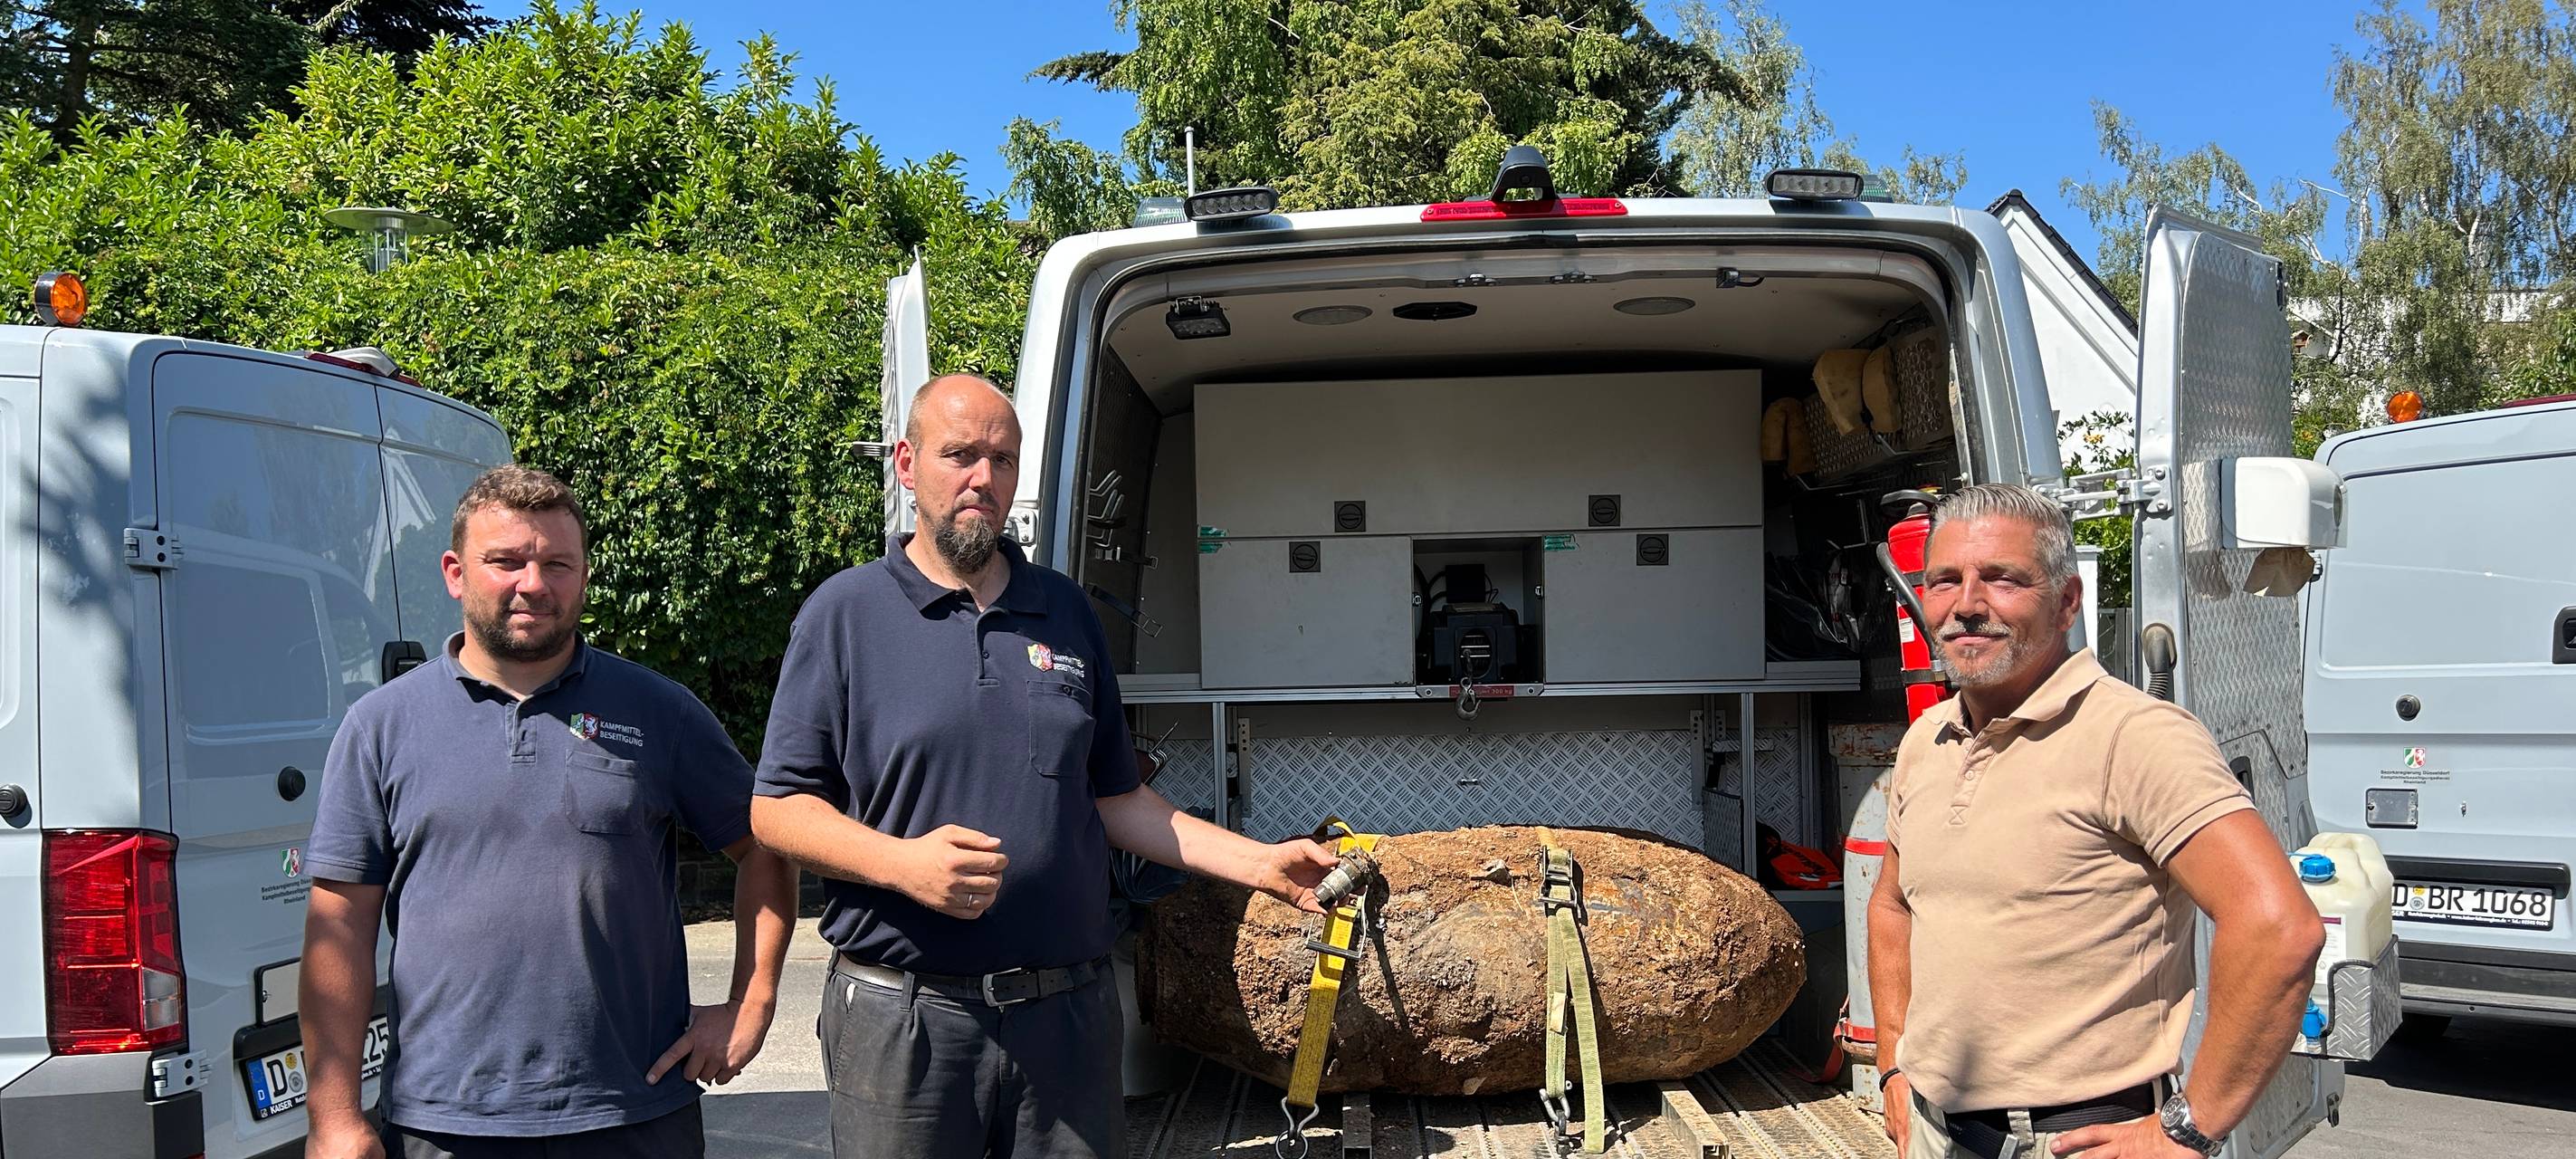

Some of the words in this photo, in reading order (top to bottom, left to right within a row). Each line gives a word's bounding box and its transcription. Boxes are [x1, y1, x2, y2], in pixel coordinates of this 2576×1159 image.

[599, 721, 644, 737] KAMPFMITTEL-
[599, 731, 644, 747] BESEITIGUNG
[2392, 883, 2409, 907] D
[2428, 886, 2464, 911] BR
[2471, 887, 2546, 917] 1068
[267, 1058, 288, 1097] D
[257, 1089, 265, 1101] D
[270, 1099, 293, 1115] KAISER
